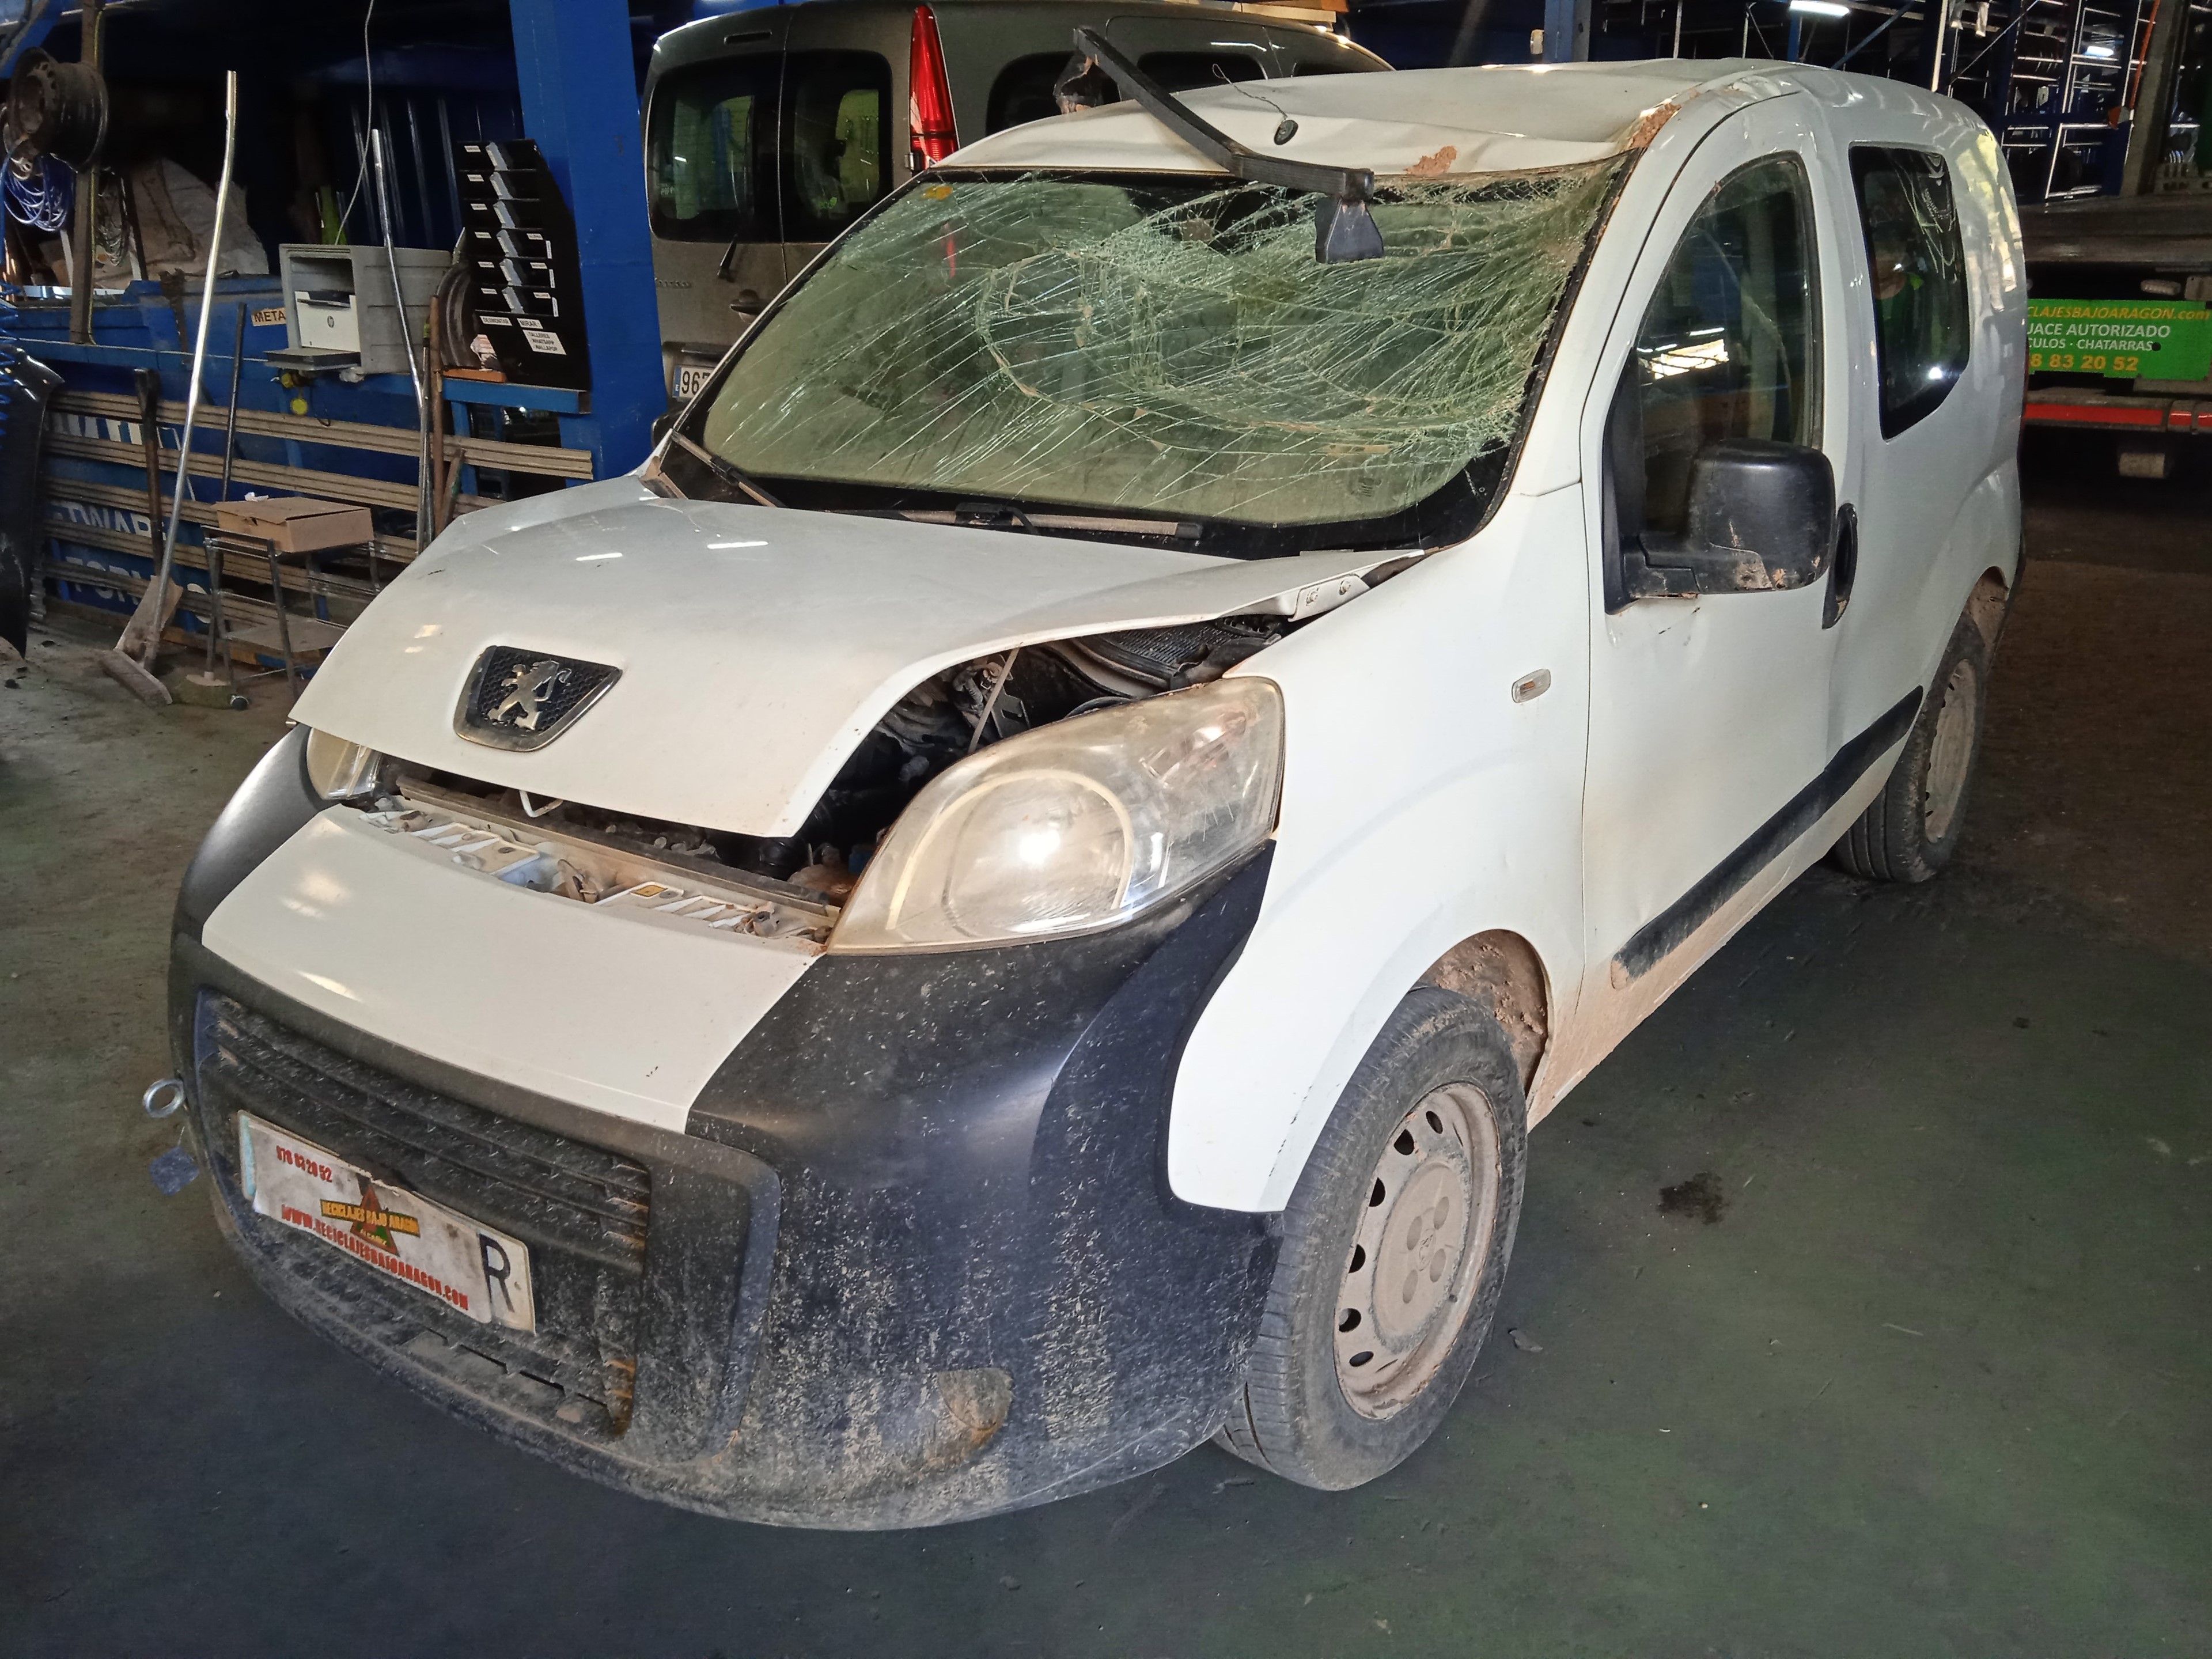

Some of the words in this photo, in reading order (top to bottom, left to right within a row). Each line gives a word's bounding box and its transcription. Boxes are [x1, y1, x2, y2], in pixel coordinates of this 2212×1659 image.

[2066, 324, 2171, 338] AUTORIZADO
[2077, 339, 2154, 351] CHATARRAS
[2049, 354, 2074, 368] 83
[2081, 355, 2106, 369] 20
[2113, 357, 2139, 371] 52
[479, 1233, 515, 1313] R
